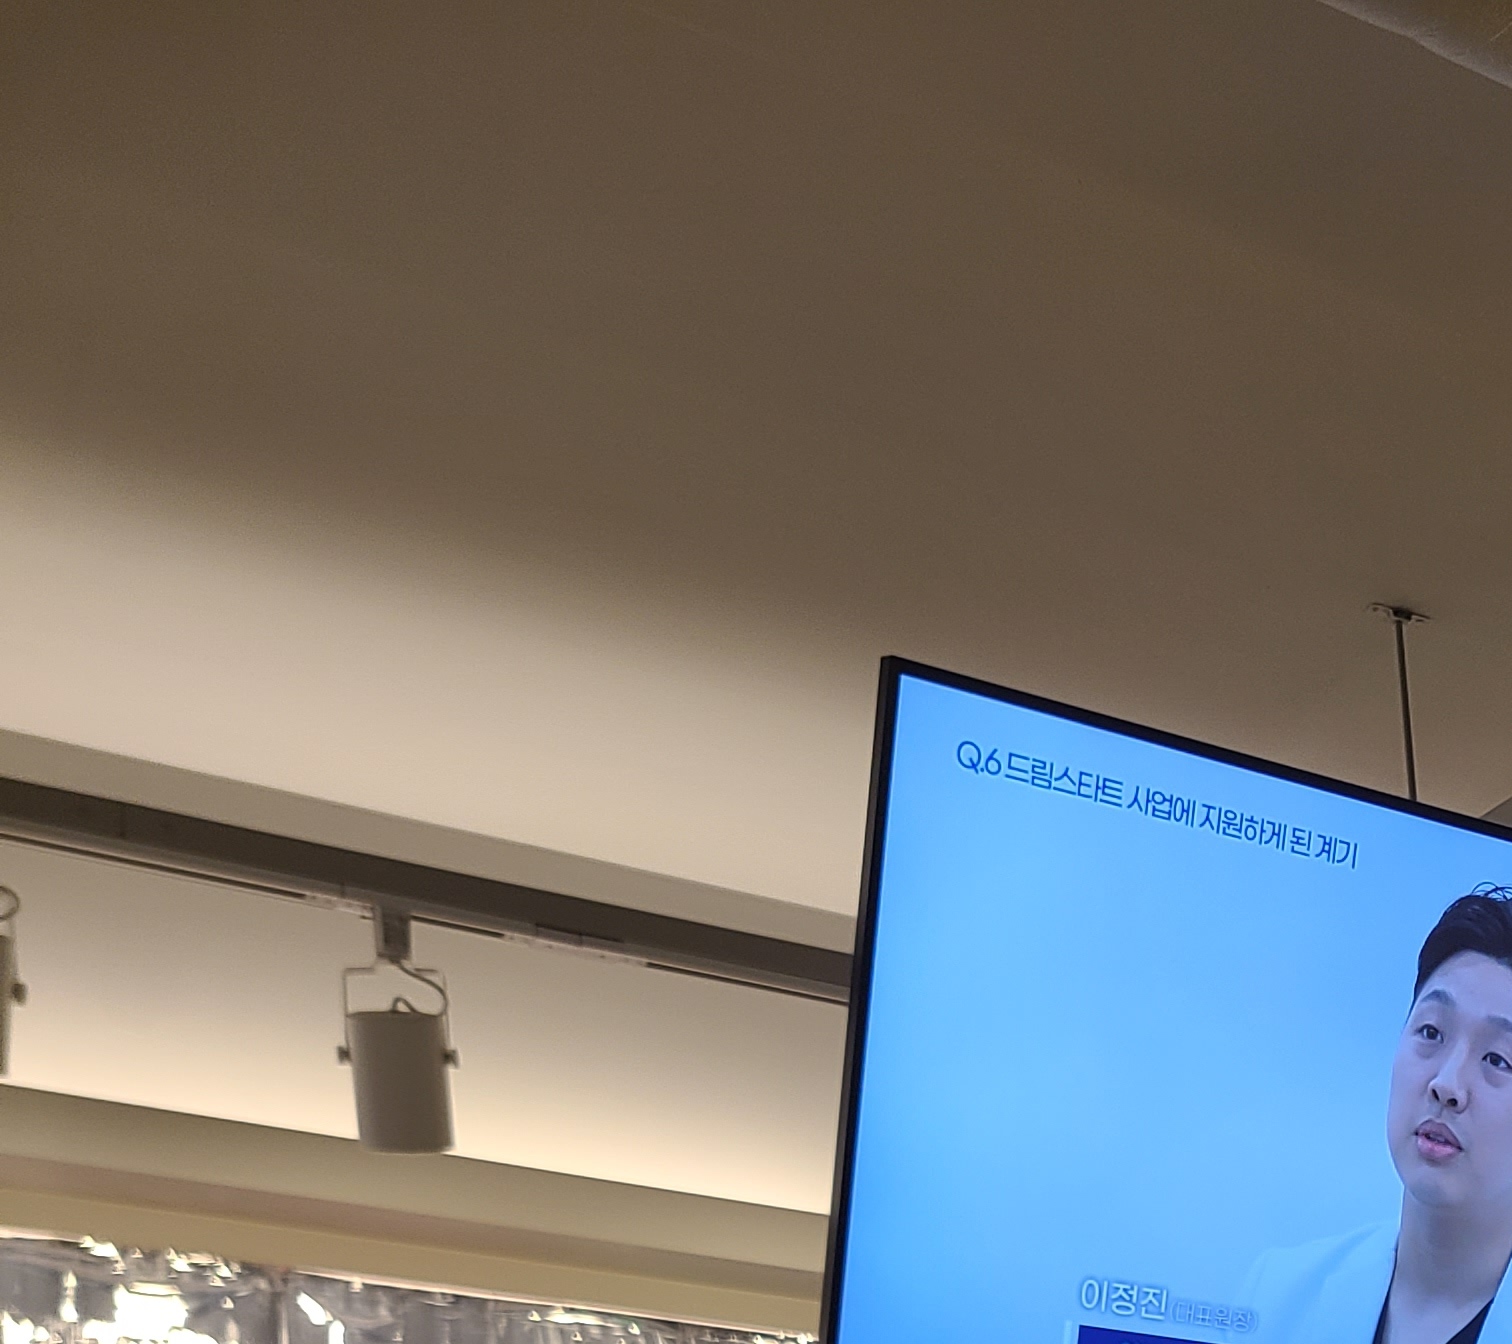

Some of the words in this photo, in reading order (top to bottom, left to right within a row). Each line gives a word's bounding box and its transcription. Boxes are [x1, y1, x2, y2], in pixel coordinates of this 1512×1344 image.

[957, 740, 1001, 775] Q.6
[1005, 751, 1125, 808] 드림스타트
[1126, 785, 1197, 829] 사업에
[1198, 802, 1288, 852] 지원하게
[1289, 827, 1312, 859] 된
[1314, 832, 1359, 870] 계기
[1081, 1278, 1169, 1322] 이정진
[1170, 1299, 1260, 1334] (대표원장)
